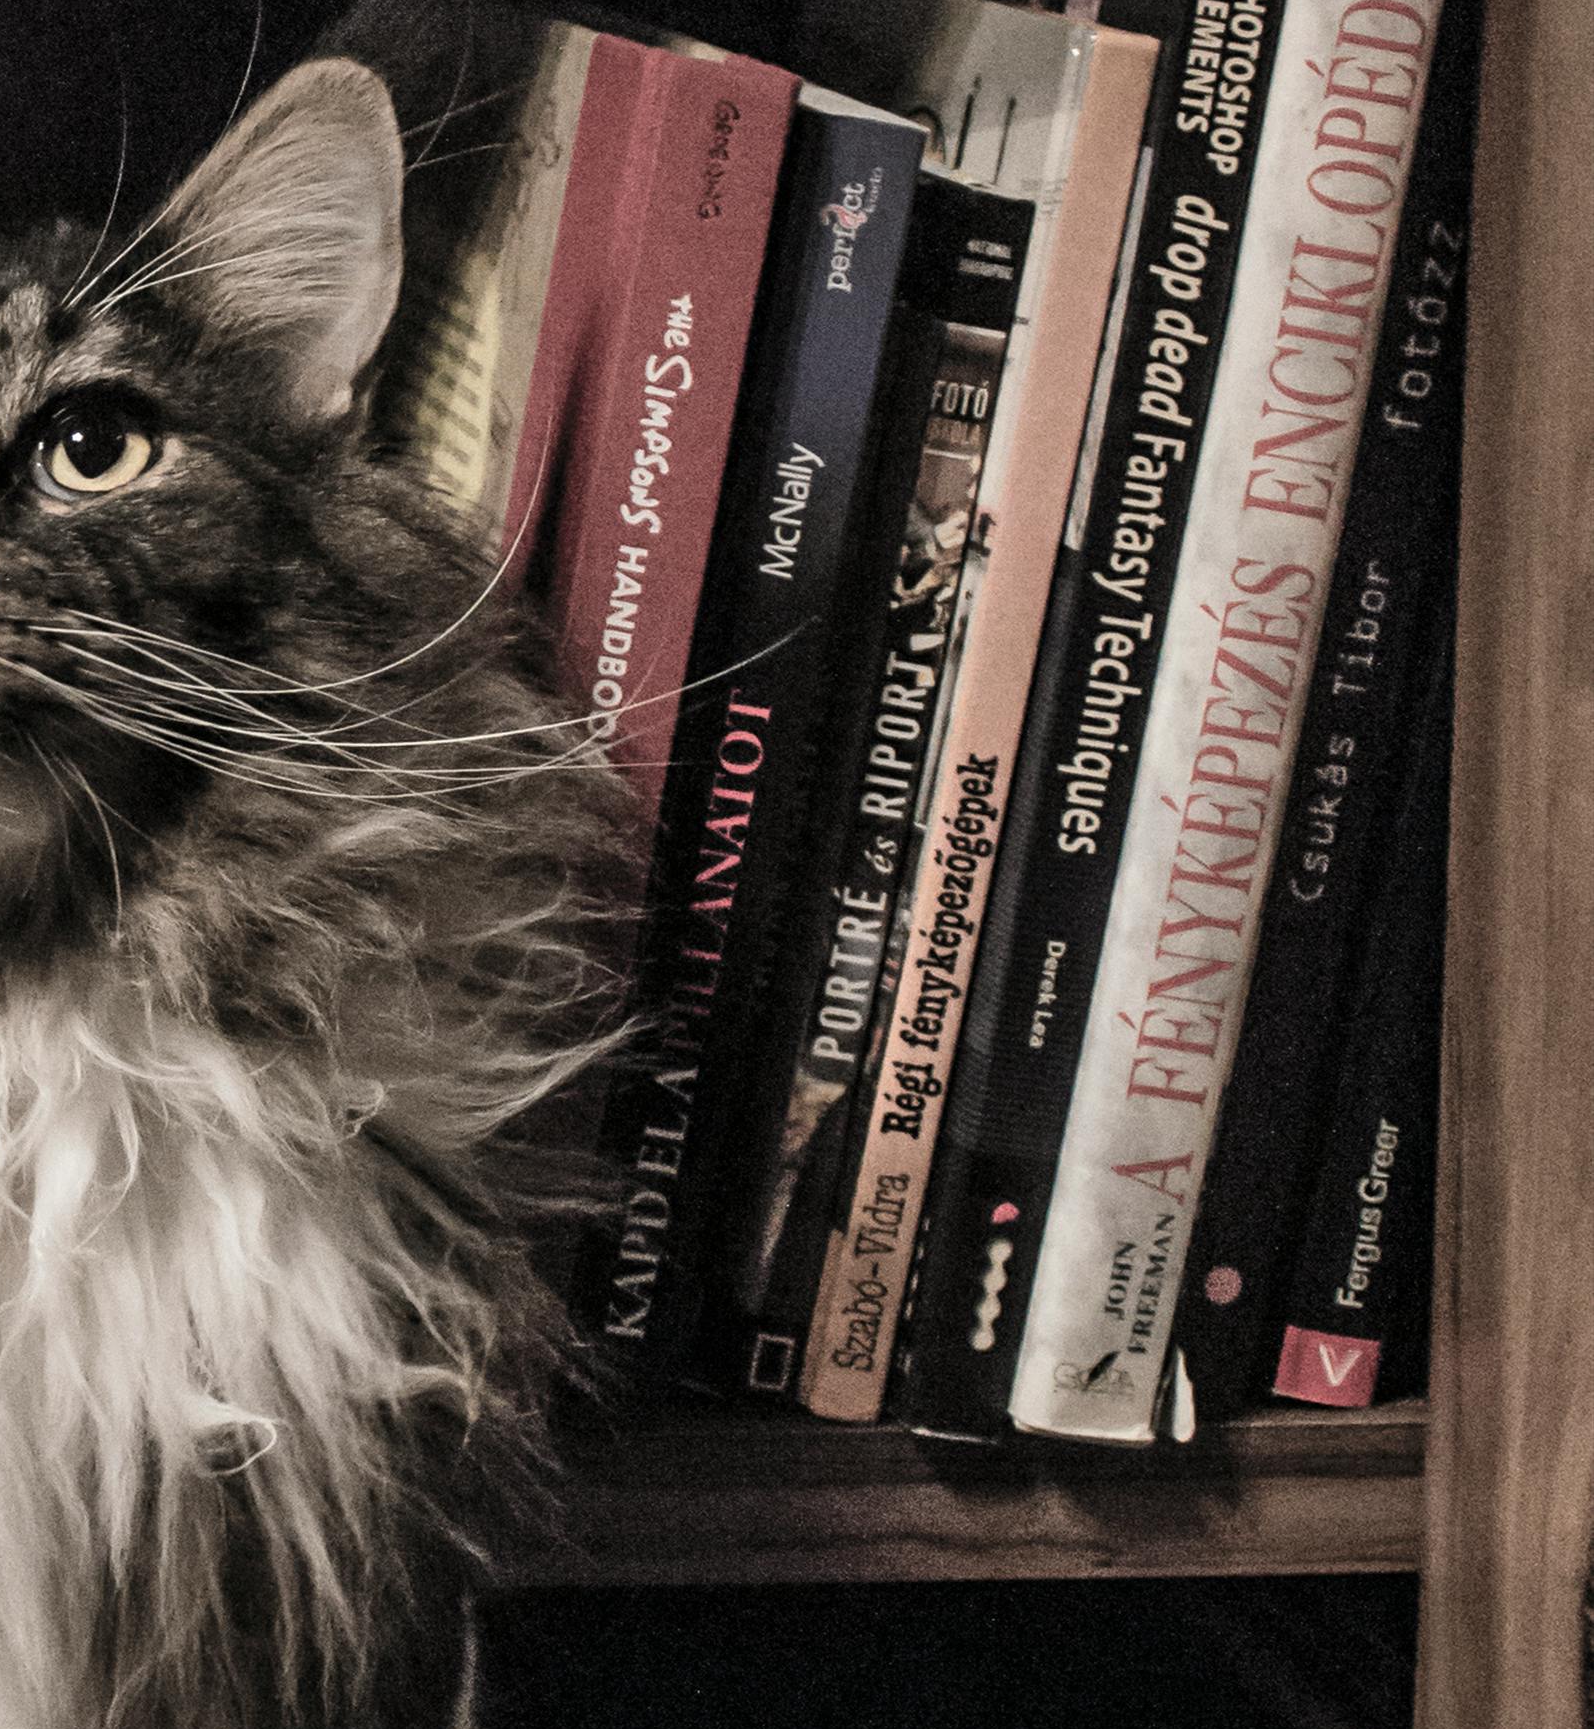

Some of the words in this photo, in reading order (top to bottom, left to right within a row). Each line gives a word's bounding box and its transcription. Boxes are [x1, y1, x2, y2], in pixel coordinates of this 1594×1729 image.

[1148, 194, 1230, 301] drop
[1138, 309, 1208, 428] dead
[757, 442, 828, 582] McNally
[1090, 432, 1188, 599] Fantasy
[859, 649, 936, 820] RIPORT
[1055, 613, 1155, 856] Techniques
[662, 688, 774, 1052] PILLANATOT
[861, 835, 902, 874] és
[1115, 555, 1317, 1113] FÉNYKÉPEZÉS
[896, 752, 1002, 1053] fényképezőgépek
[810, 884, 889, 1063] PORTRÉ
[1027, 1010, 1053, 1049] Lea
[1034, 938, 1067, 1009] Derek
[655, 1064, 701, 1105] A
[879, 1058, 944, 1141] Régi
[634, 1114, 691, 1178] EL
[1107, 1147, 1197, 1207] A
[1358, 1117, 1403, 1204] Greer
[604, 1189, 672, 1341] KAPD
[829, 1171, 910, 1372] Szabó-Vidra
[1102, 1237, 1140, 1323] JOHN
[1125, 1211, 1177, 1357] FREEMAN
[1336, 1205, 1386, 1310] Fergus
